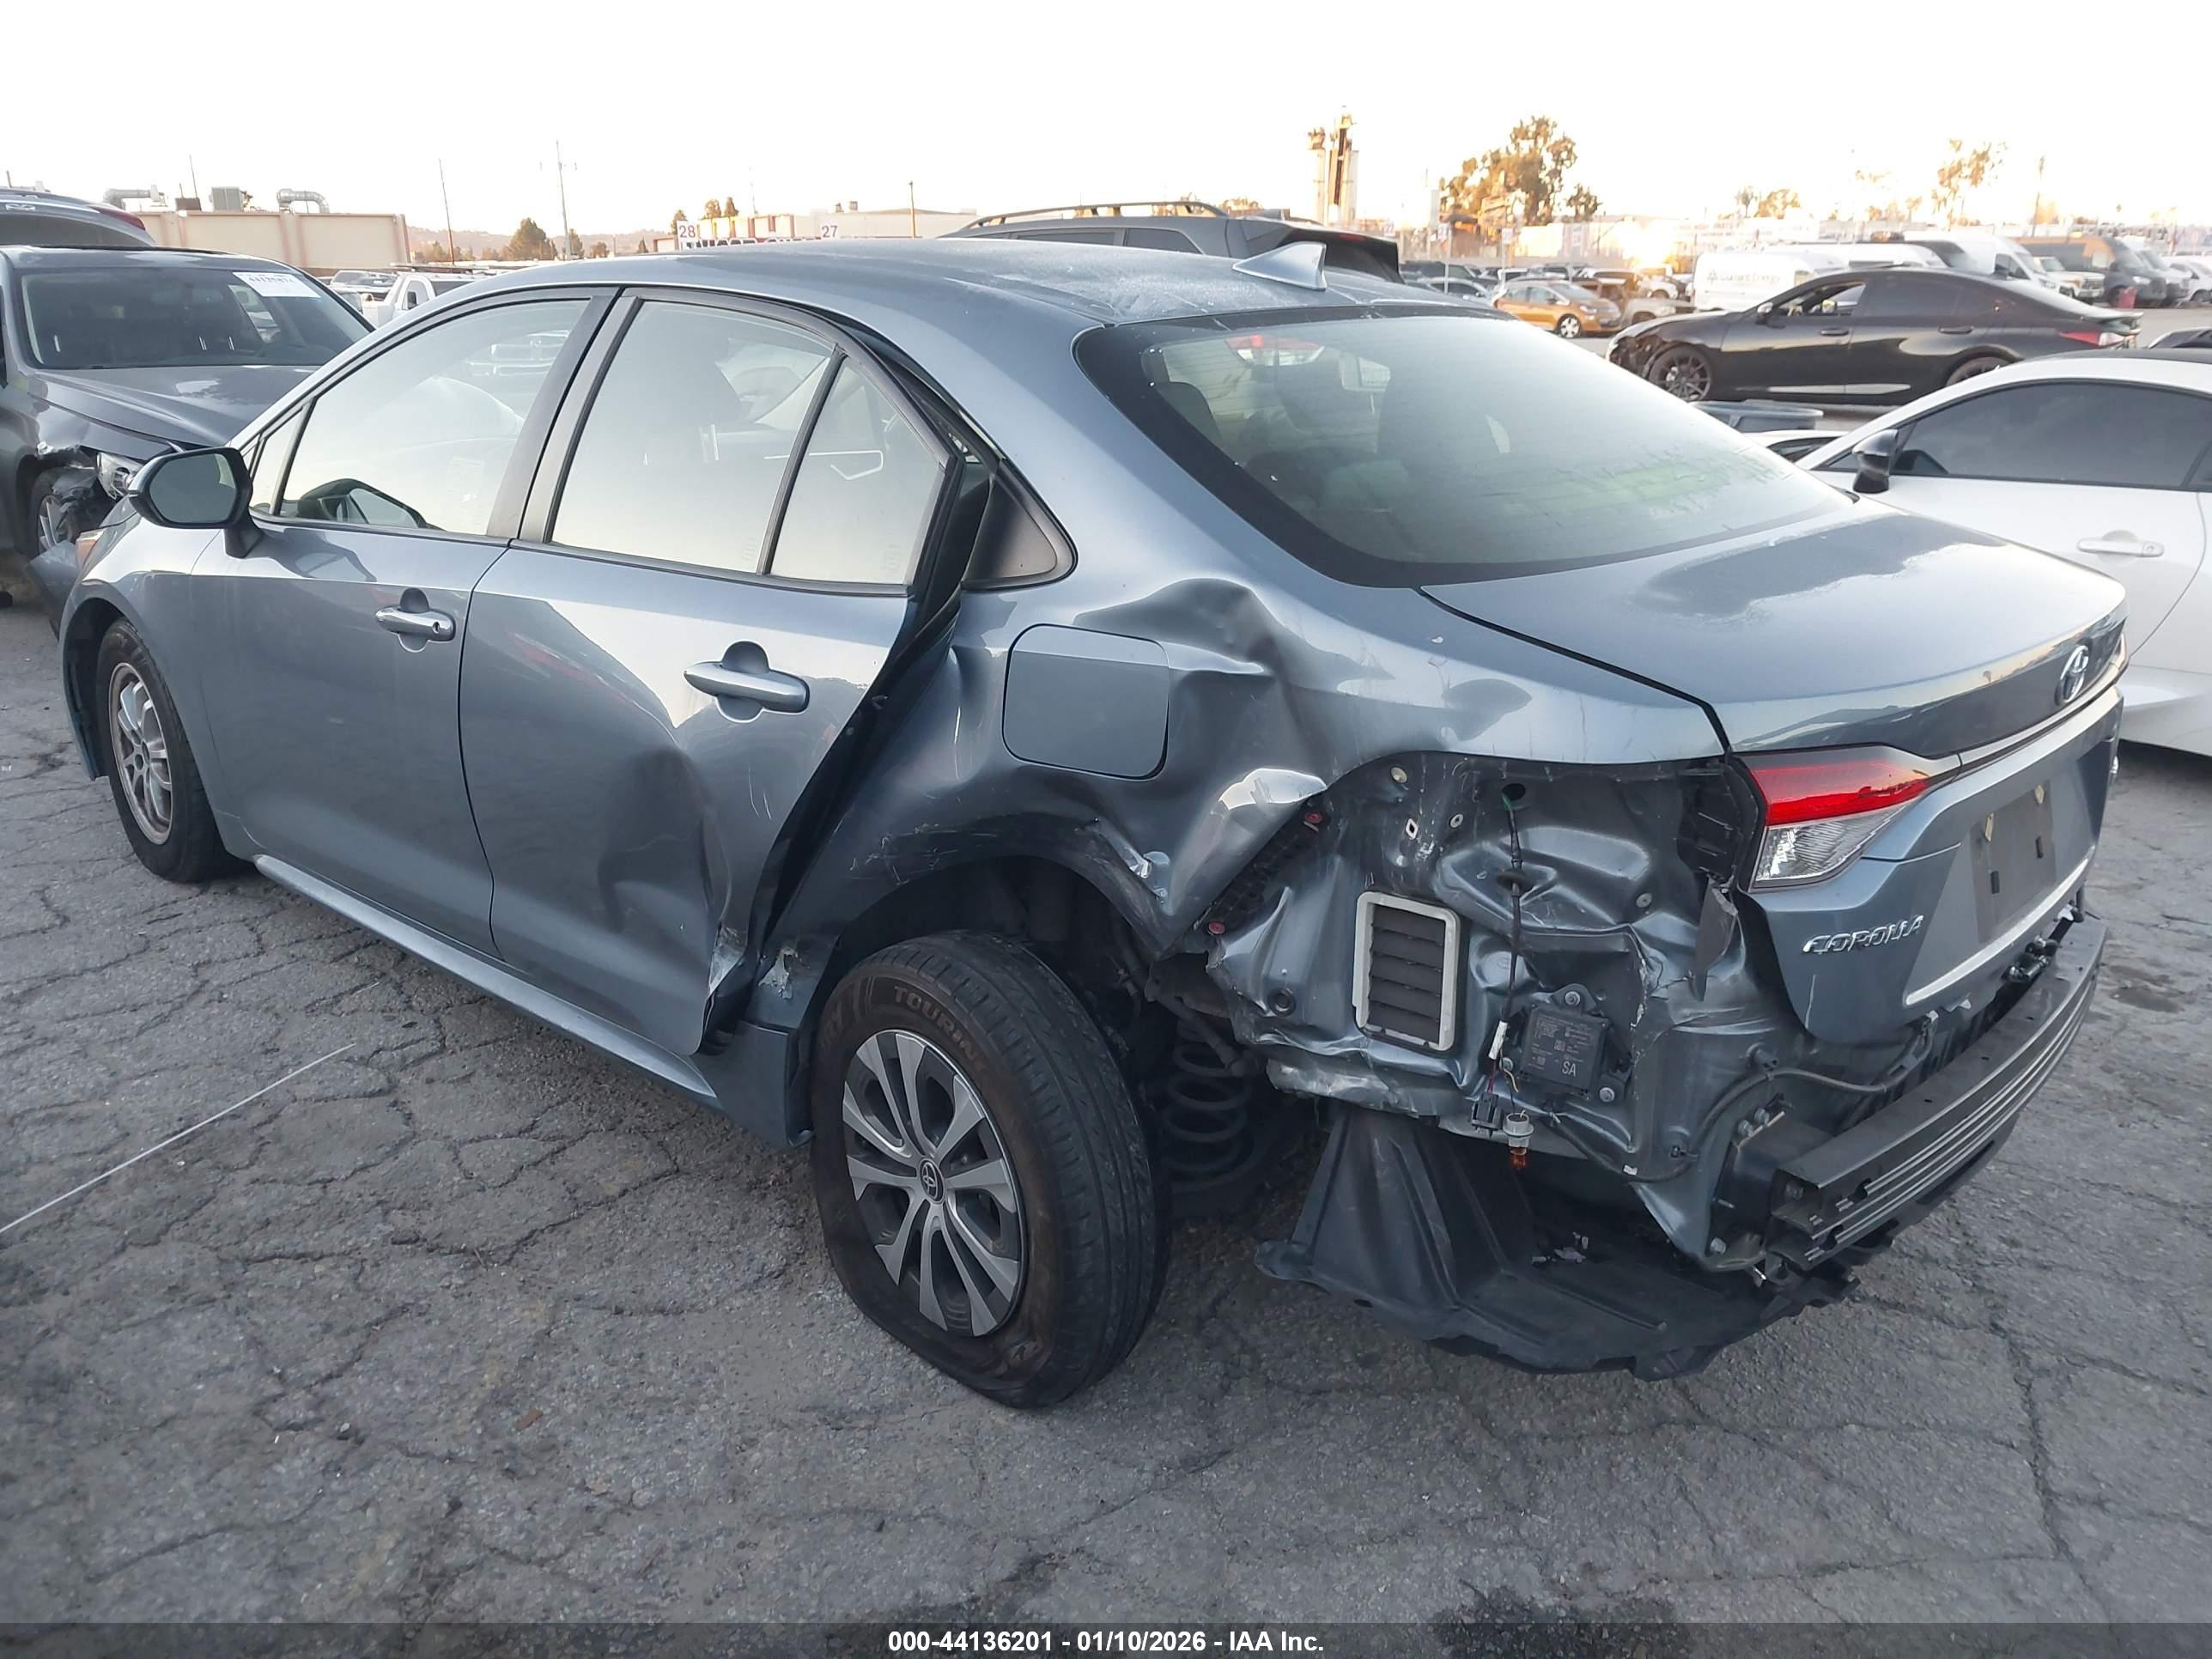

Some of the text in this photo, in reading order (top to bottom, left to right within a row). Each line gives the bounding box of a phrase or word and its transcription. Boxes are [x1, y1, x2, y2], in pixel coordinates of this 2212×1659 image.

[678, 224, 696, 238] 28
[822, 225, 837, 238] 27
[1802, 915, 1924, 954] COROLLA
[1562, 1060, 1577, 1077] SA
